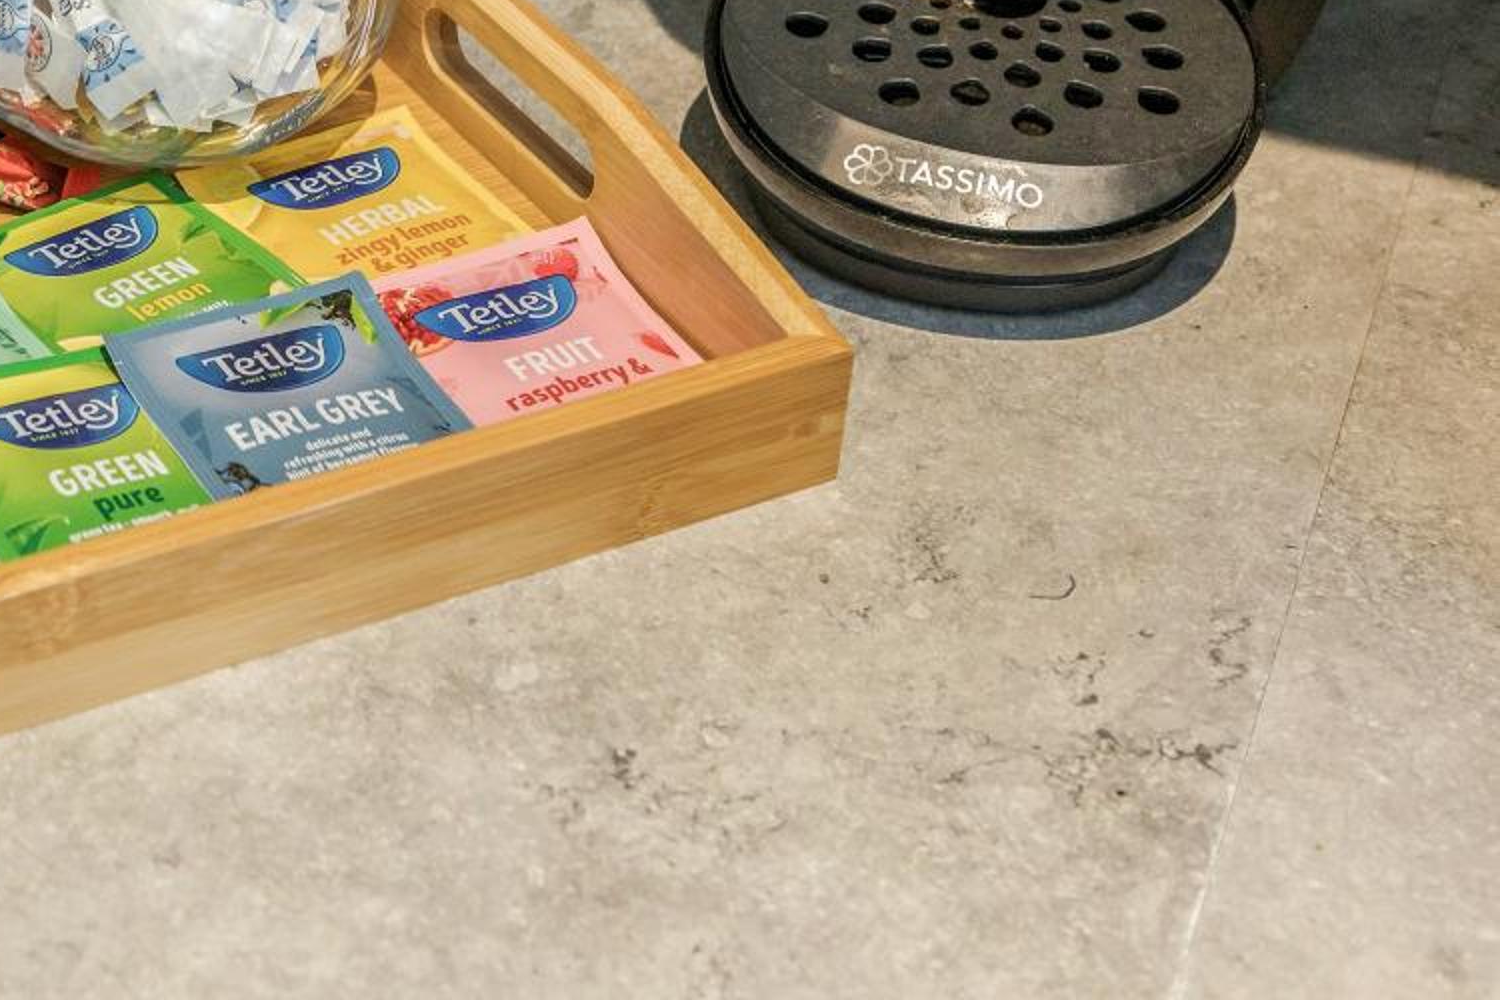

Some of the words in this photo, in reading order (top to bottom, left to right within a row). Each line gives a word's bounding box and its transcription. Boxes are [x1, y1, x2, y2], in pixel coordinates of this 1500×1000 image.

[271, 153, 383, 201] Tetley
[895, 157, 1044, 209] TASSIMO
[28, 215, 142, 270] Tetley
[319, 194, 447, 246] HERBAL
[337, 231, 400, 266] zingy
[400, 212, 474, 242] lemon
[371, 254, 395, 274] &
[399, 232, 471, 270] ginger
[93, 257, 200, 310] GREEN
[126, 281, 213, 323] lemon
[438, 284, 558, 334] Tetley
[202, 333, 325, 382] Tetley
[504, 337, 606, 383] FRUIT
[506, 364, 629, 412] raspberry
[630, 356, 654, 376] &
[224, 407, 320, 452] EARL
[316, 387, 405, 425] GREY
[305, 433, 350, 452] delicate
[351, 427, 372, 440] and
[48, 449, 169, 496] GREEN
[93, 486, 166, 522] pure
